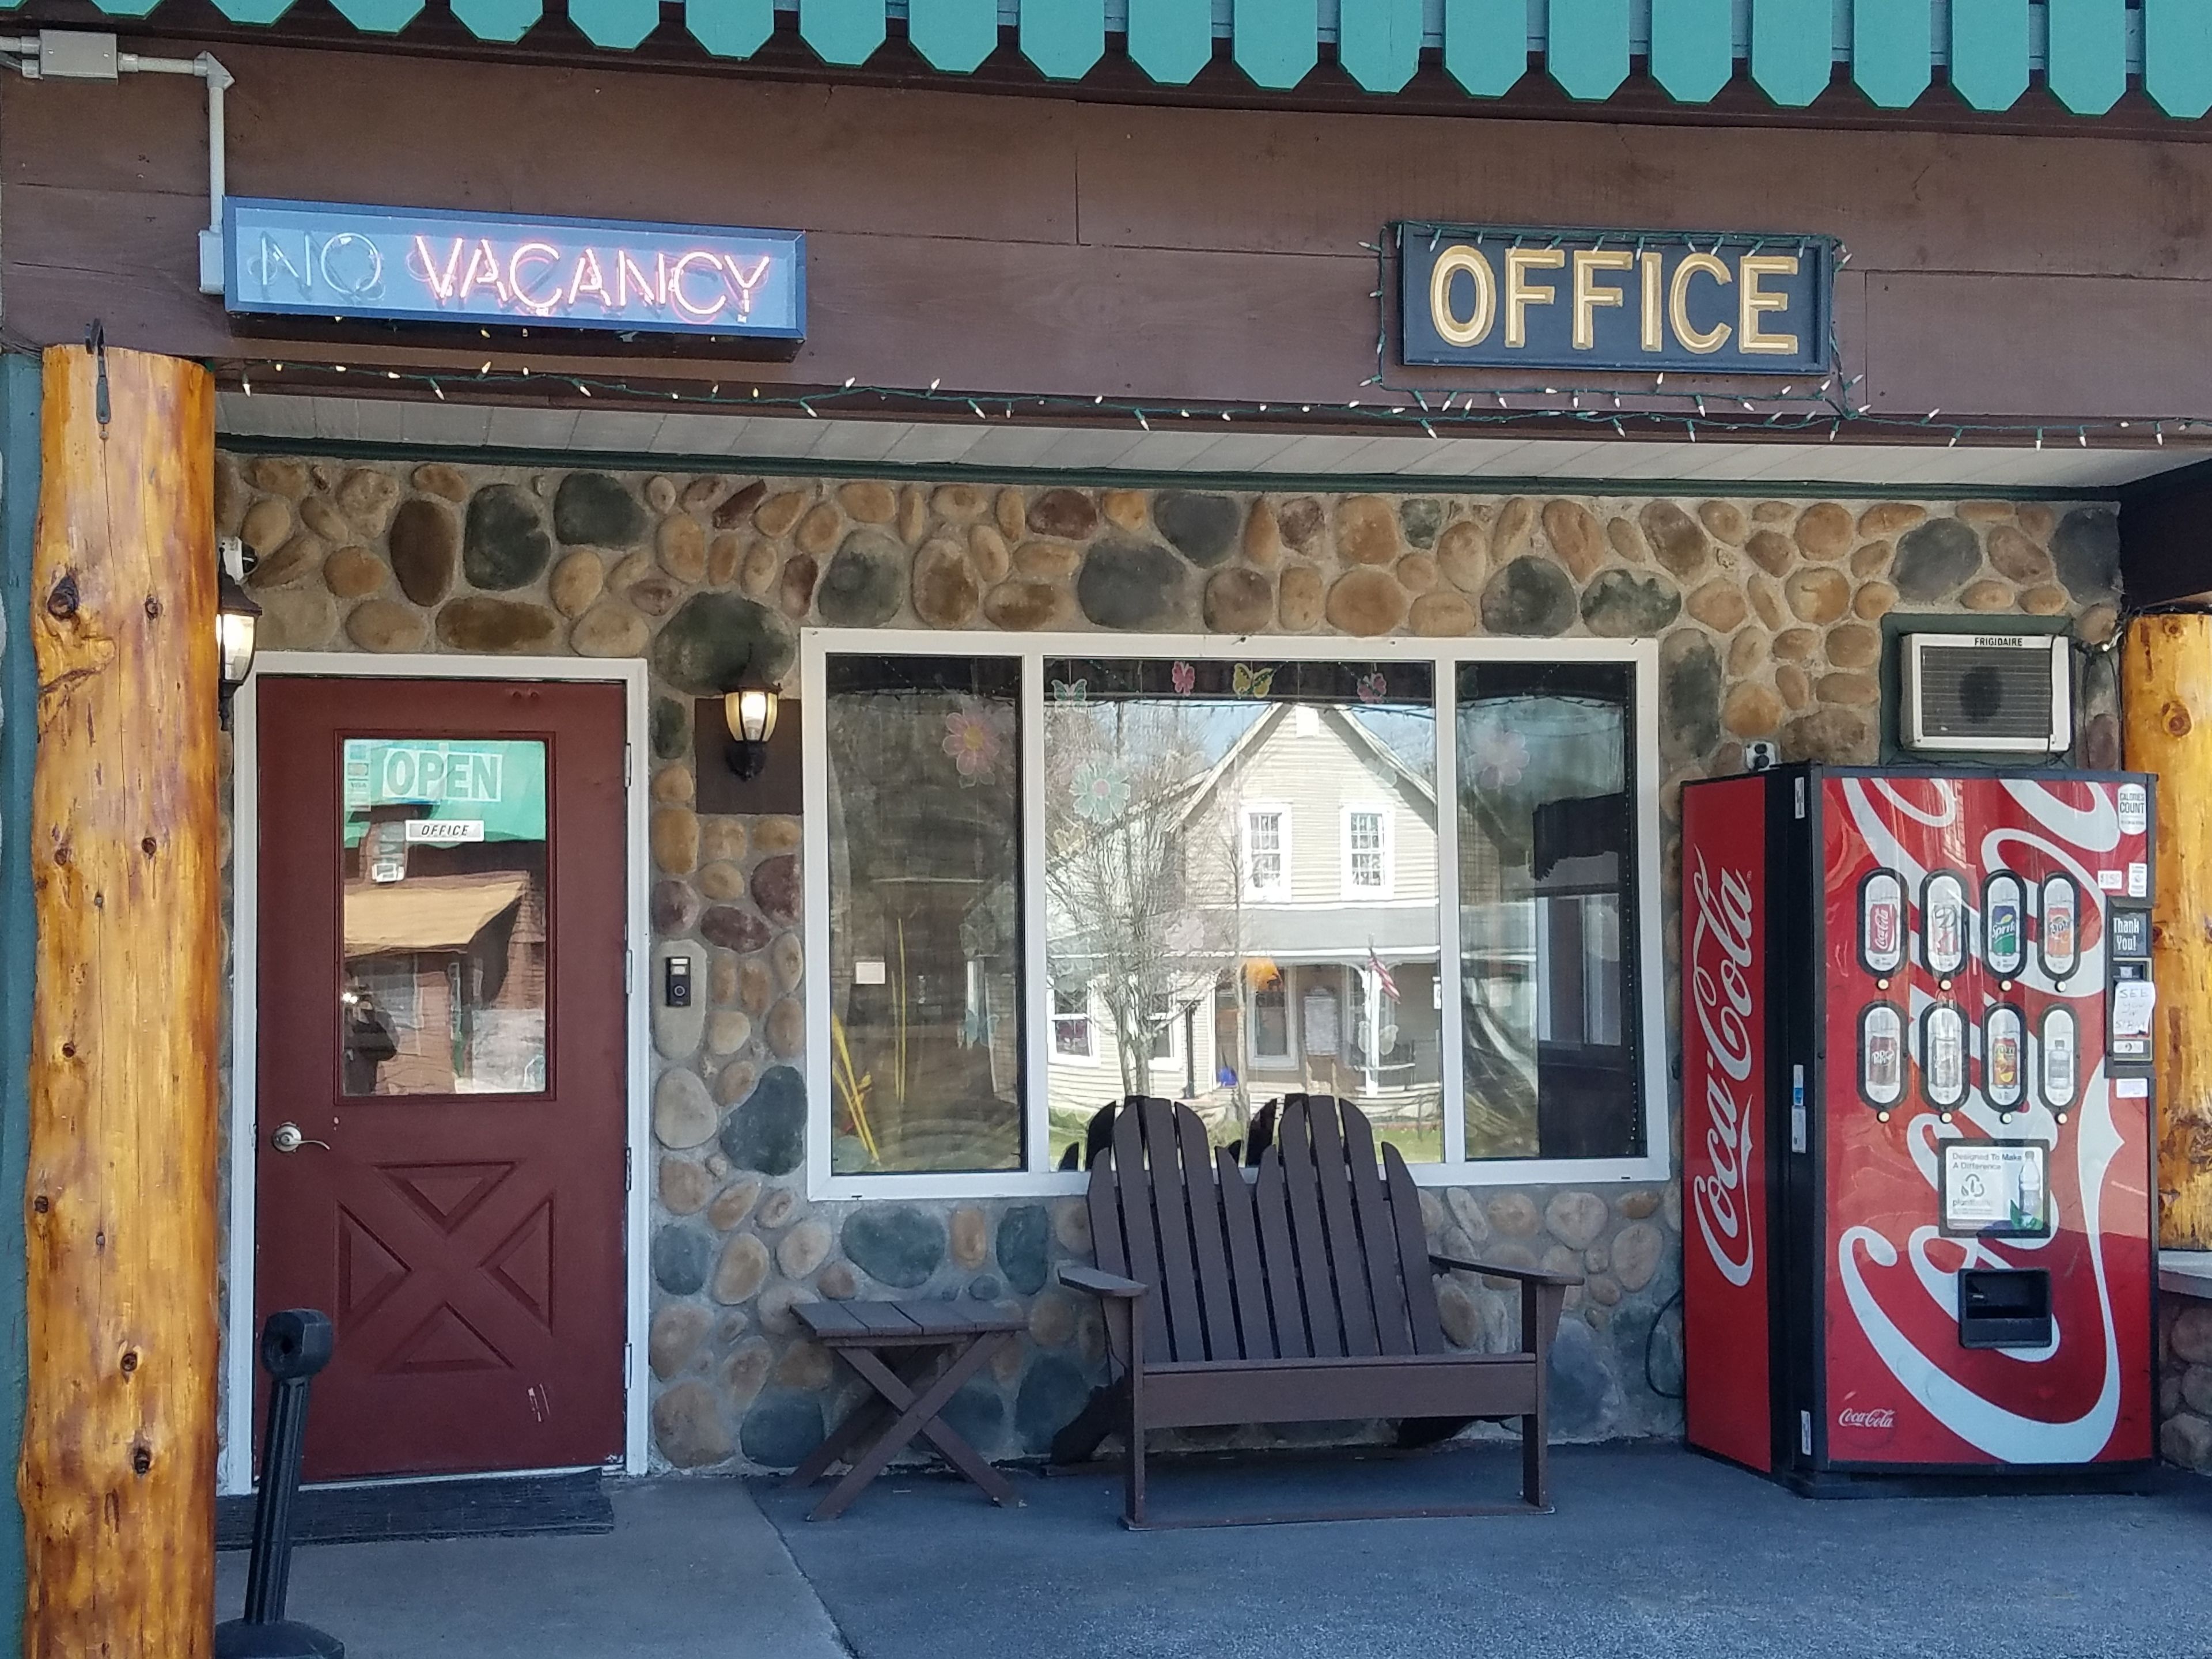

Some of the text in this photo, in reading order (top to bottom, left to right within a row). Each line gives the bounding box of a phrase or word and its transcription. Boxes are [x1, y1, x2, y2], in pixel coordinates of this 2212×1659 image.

[262, 232, 770, 320] NO VACANCY
[1430, 245, 1798, 354] OFFICE
[1974, 637, 2023, 646] FRIGIDAIRE
[386, 750, 498, 800] OPEN
[2119, 802, 2145, 813] COUNT
[421, 825, 469, 836] OFFICE
[2113, 917, 2139, 934] Thank
[2116, 935, 2137, 951] You!
[2119, 988, 2149, 998] SEE
[1693, 843, 1753, 1286] Coca-Cola
[1961, 1162, 2001, 1170] Difference
